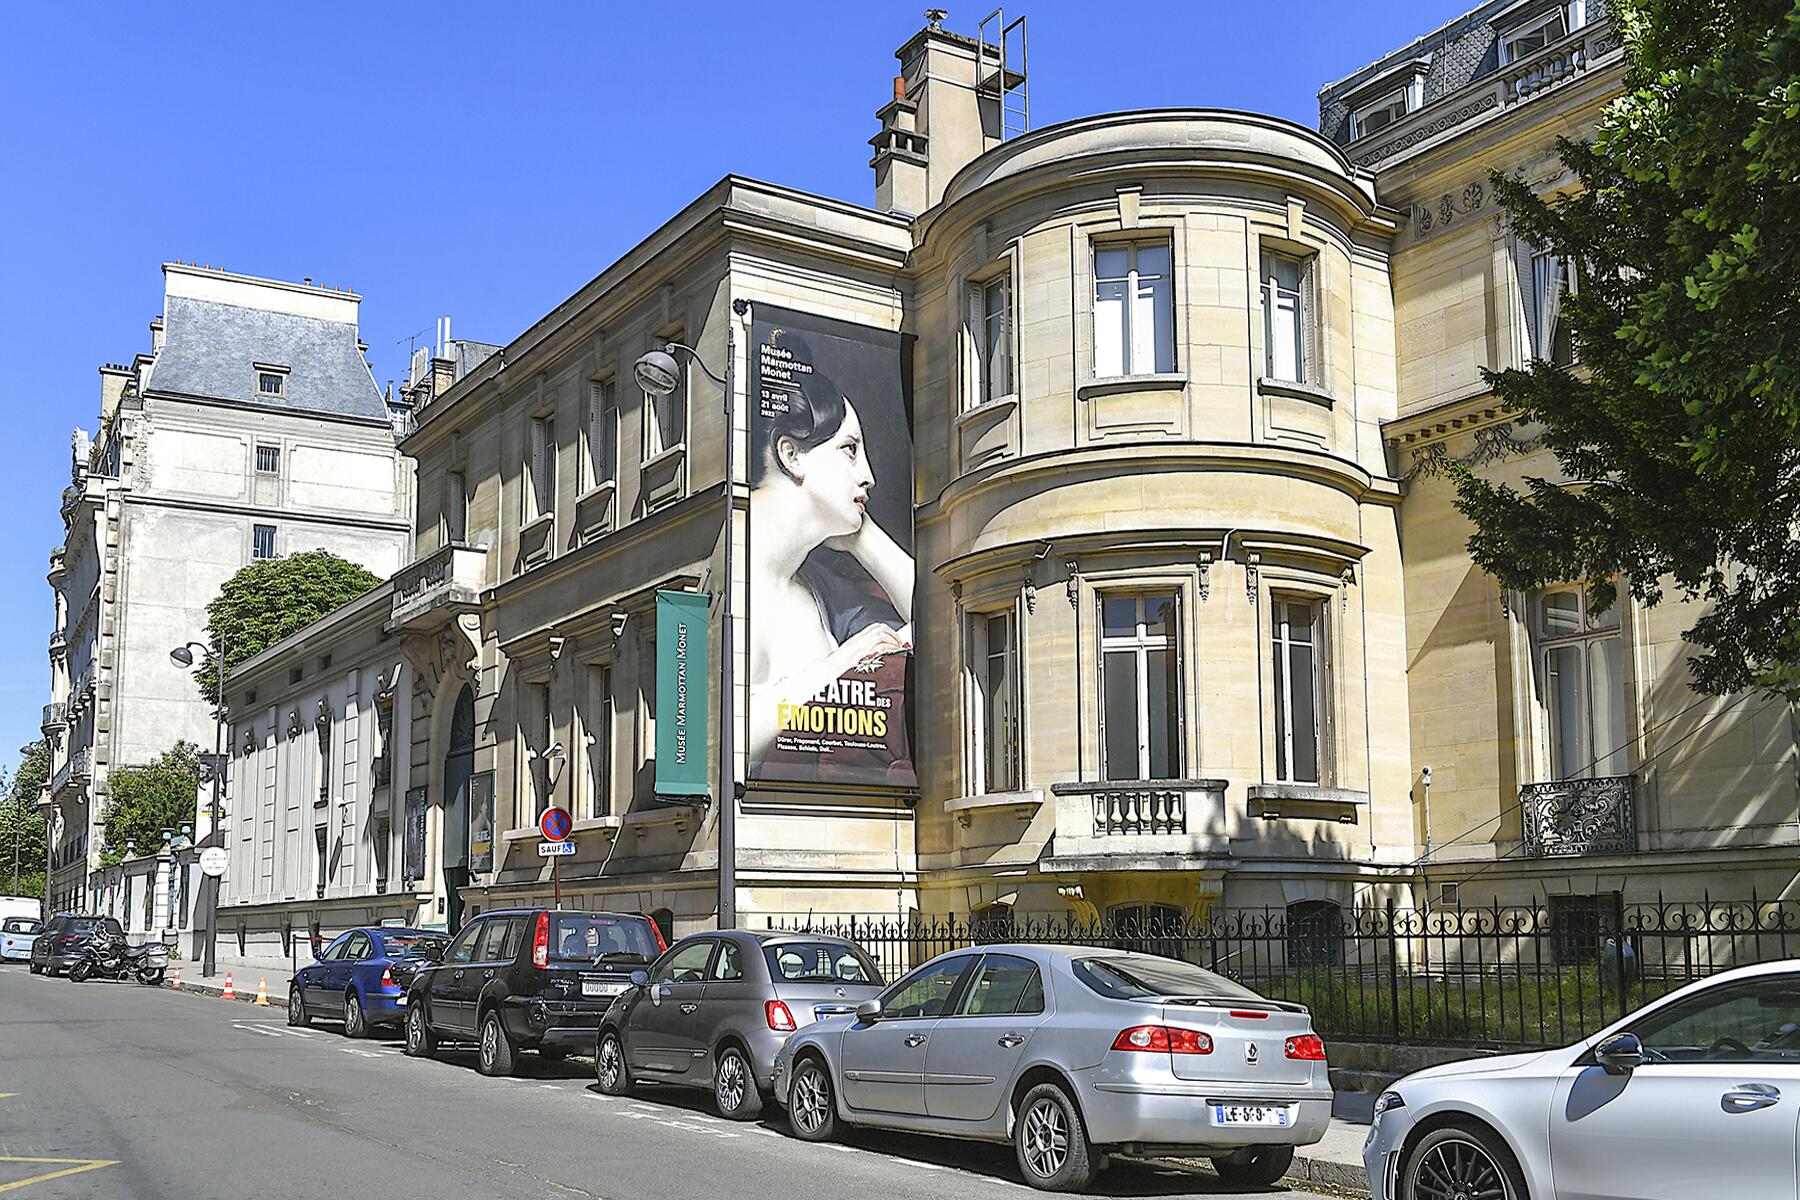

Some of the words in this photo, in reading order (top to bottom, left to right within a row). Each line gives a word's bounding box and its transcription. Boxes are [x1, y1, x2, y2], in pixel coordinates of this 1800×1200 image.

[761, 344, 792, 359] Musée
[761, 354, 813, 374] Marmottan
[761, 364, 791, 380] Monet
[761, 390, 770, 399] 13
[771, 394, 788, 402] avril
[761, 400, 770, 409] 21
[771, 404, 790, 413] août
[676, 623, 688, 659] MONET
[676, 663, 688, 726] MARMOTTAN
[876, 698, 892, 708] DES
[777, 697, 888, 737] ÉMOTIONS
[675, 729, 687, 764] MUSÉE
[540, 845, 562, 854] SAUF
